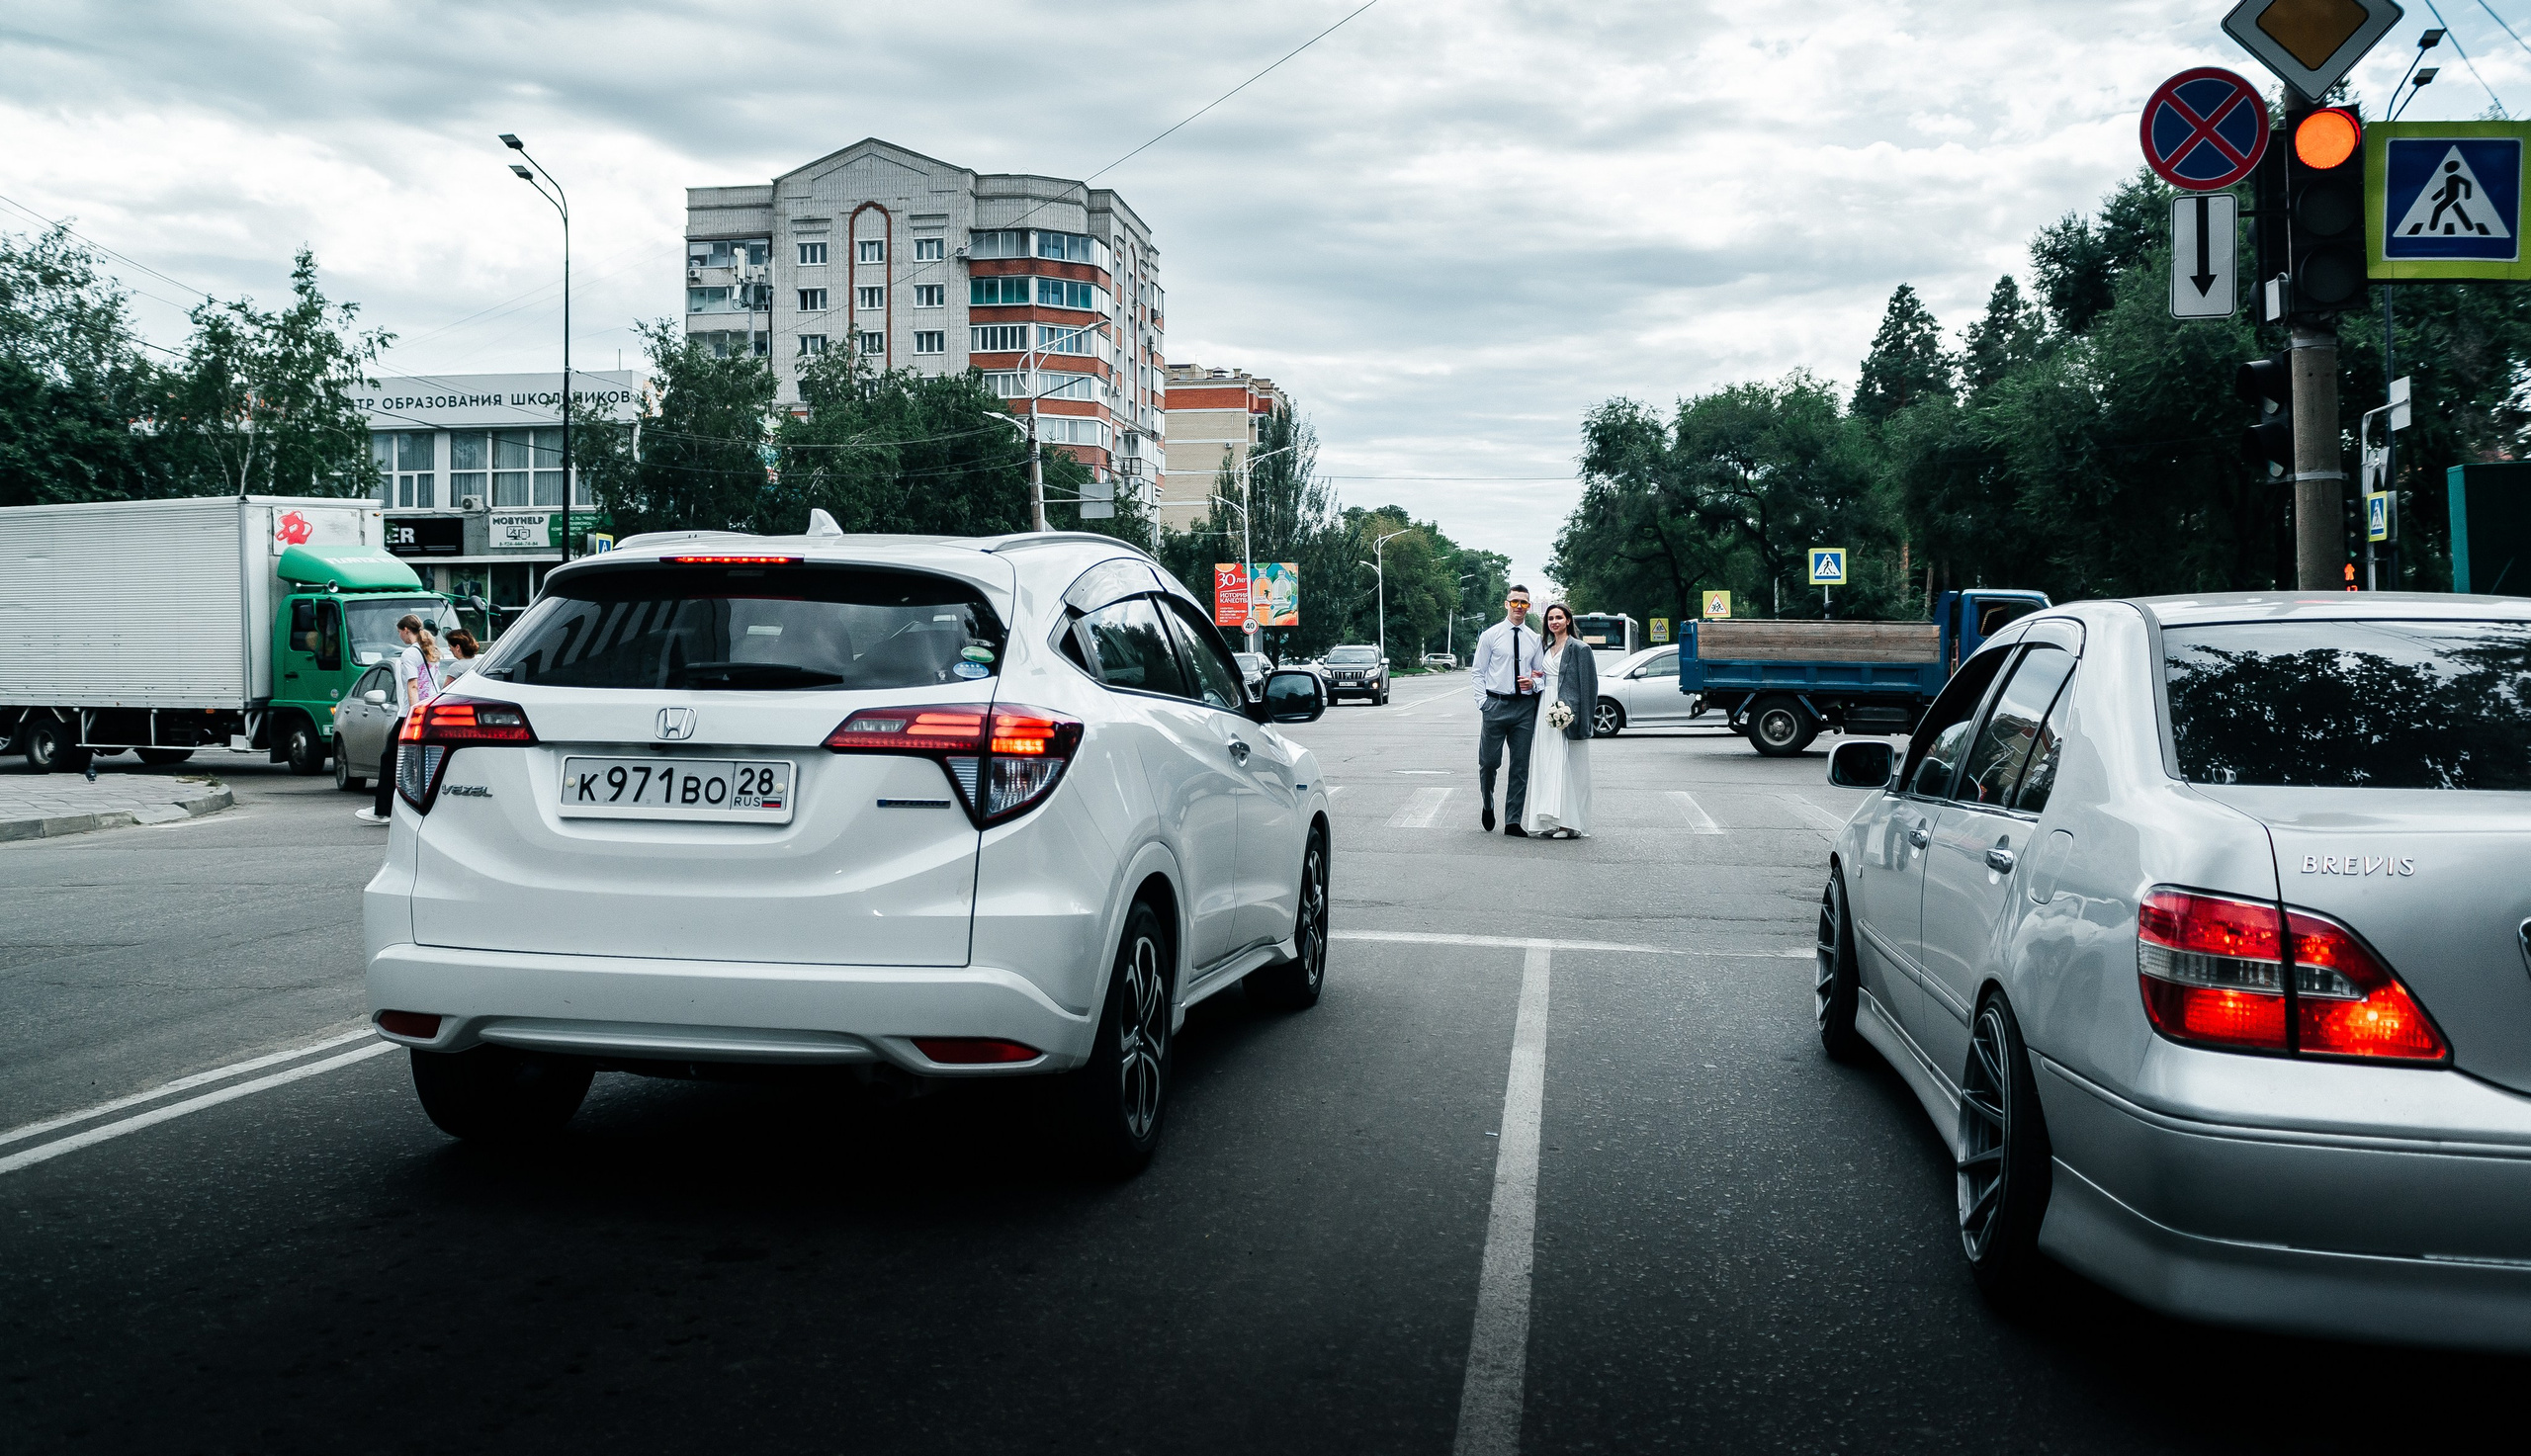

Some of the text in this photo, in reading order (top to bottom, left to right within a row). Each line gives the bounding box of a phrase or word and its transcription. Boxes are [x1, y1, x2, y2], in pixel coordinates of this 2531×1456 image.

[382, 393, 502, 410] ОБРАЗОВАНИЯ
[510, 390, 631, 406] ШКОЛНИКОВ
[1218, 573, 1236, 589] 30
[738, 768, 774, 795] 28
[441, 784, 493, 798] VEZEL
[734, 797, 760, 808] RUS
[2301, 854, 2415, 876] BREVIS
